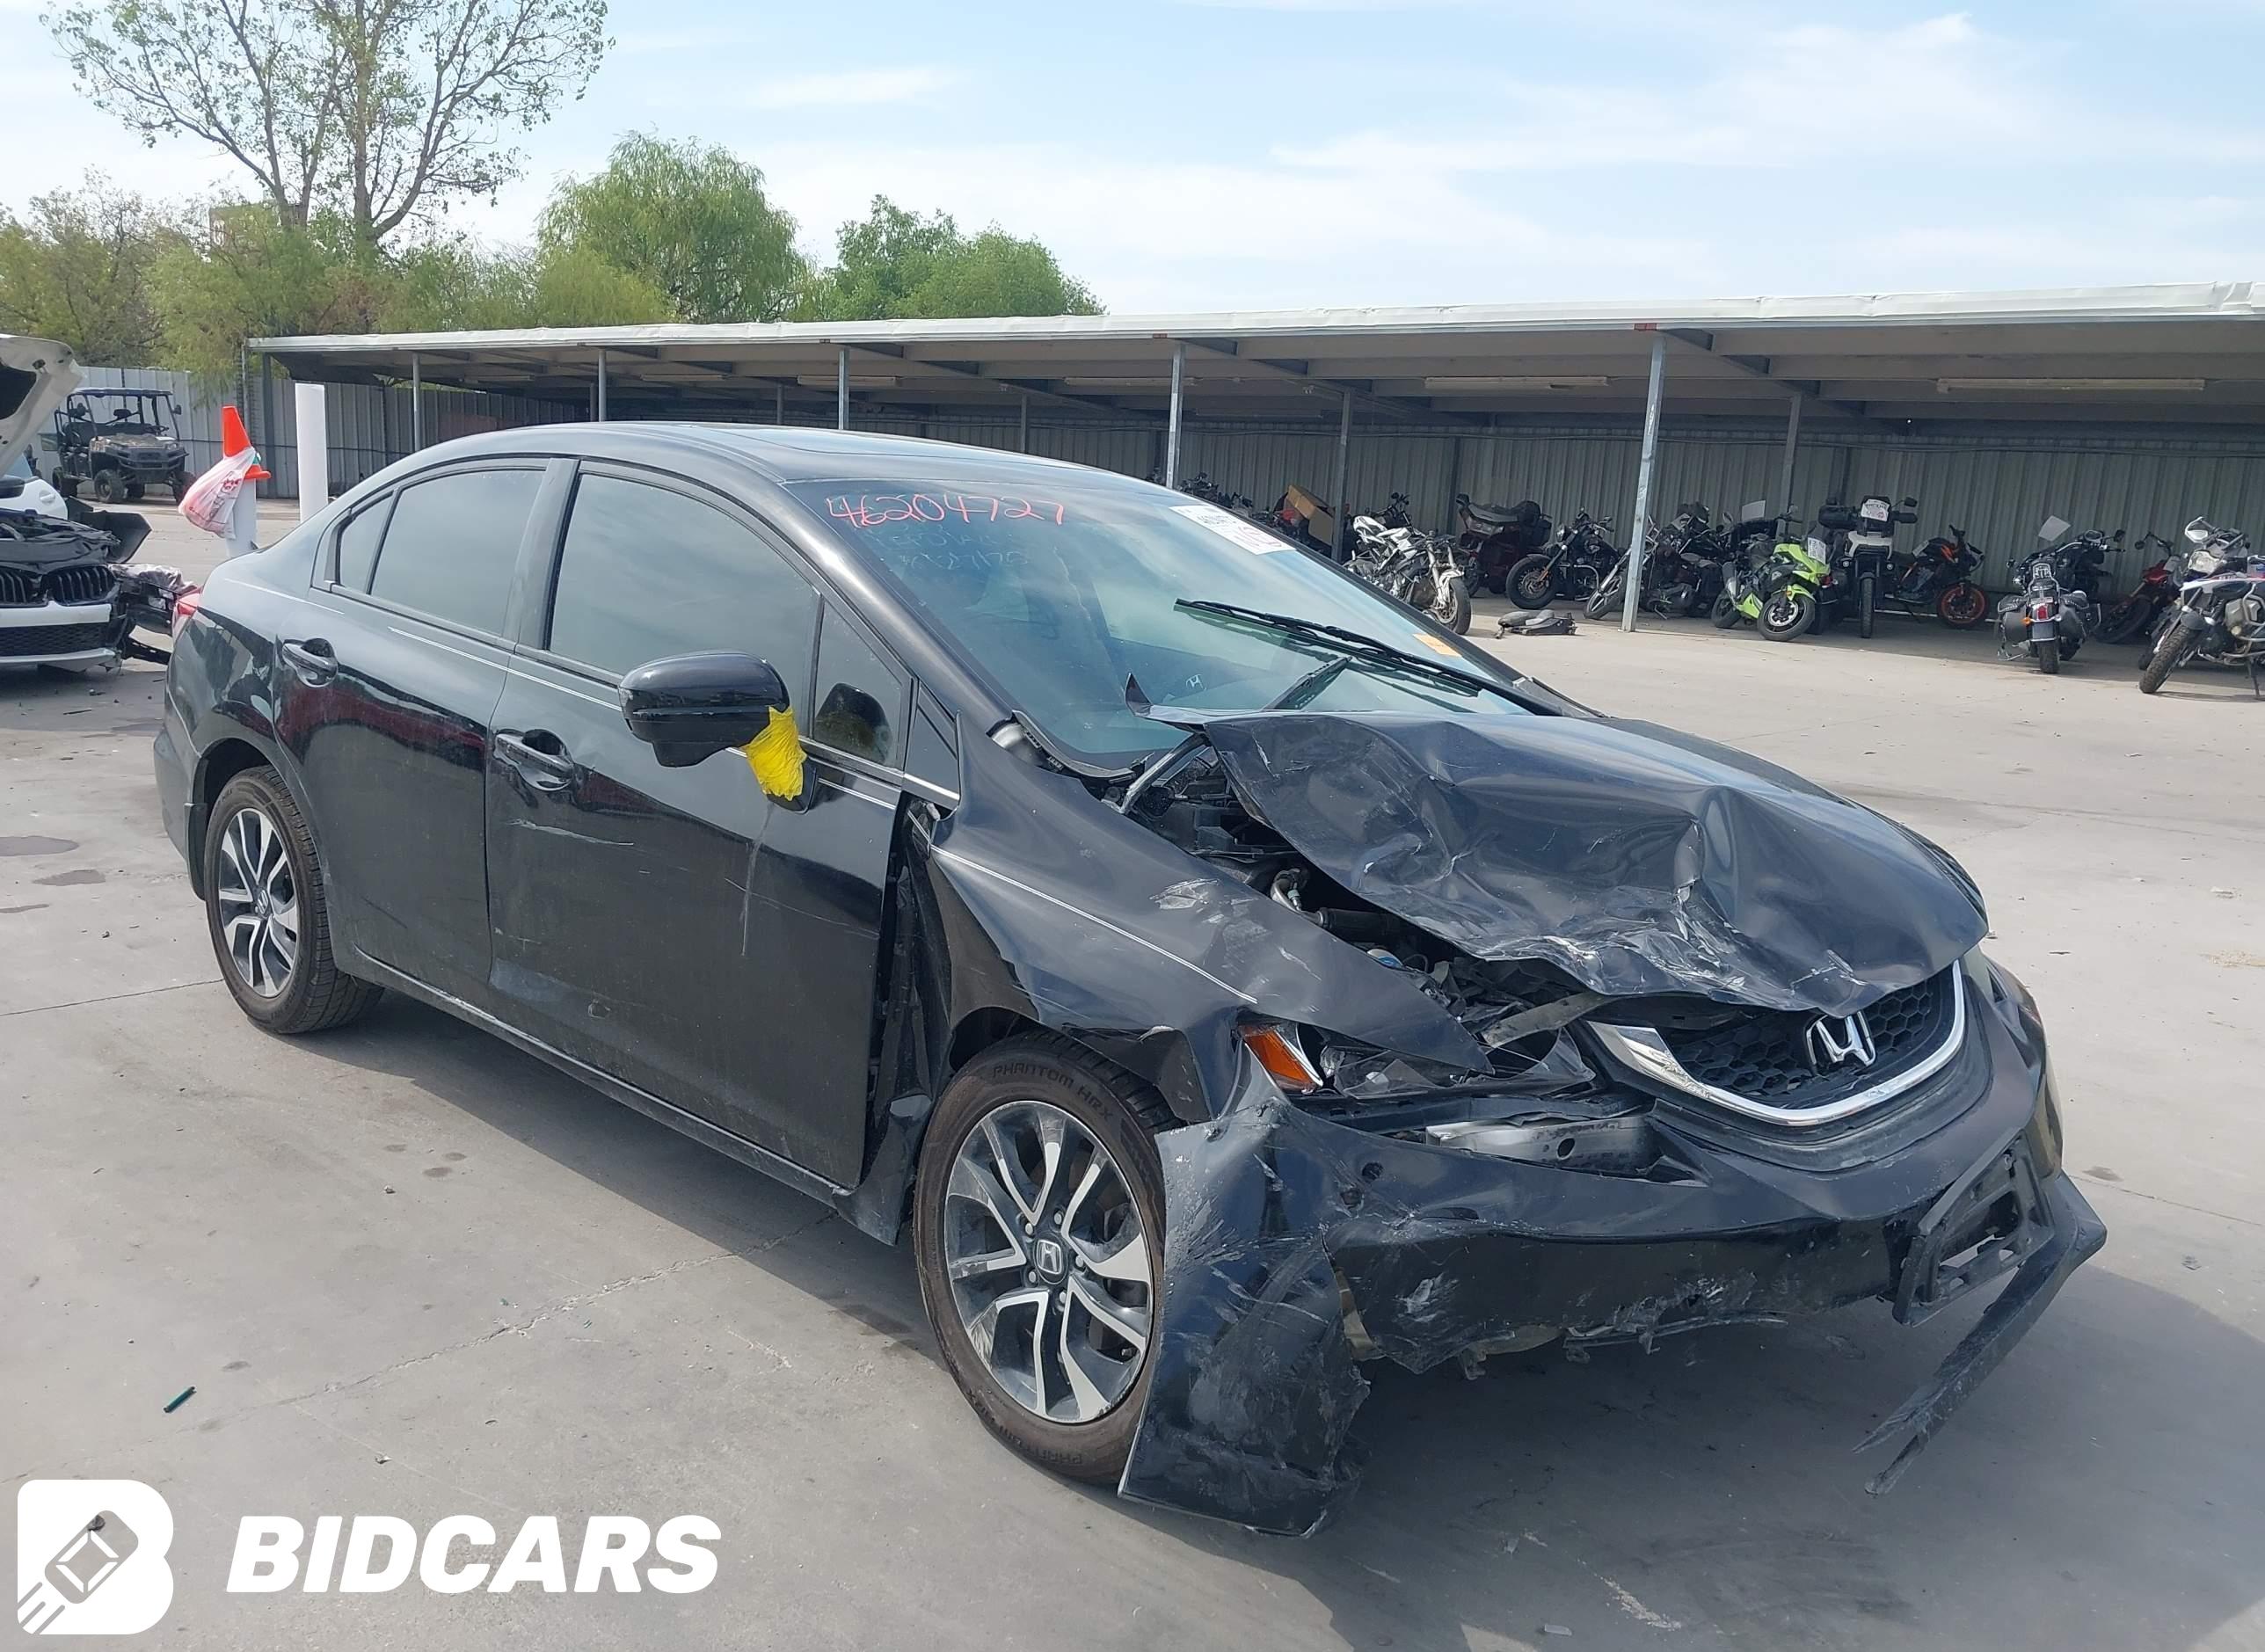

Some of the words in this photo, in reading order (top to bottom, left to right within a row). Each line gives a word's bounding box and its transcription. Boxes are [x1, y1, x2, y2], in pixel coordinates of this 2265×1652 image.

[826, 491, 1065, 528] 46204727
[993, 1062, 1074, 1089] PHANTOM
[1077, 1084, 1114, 1121] HRX
